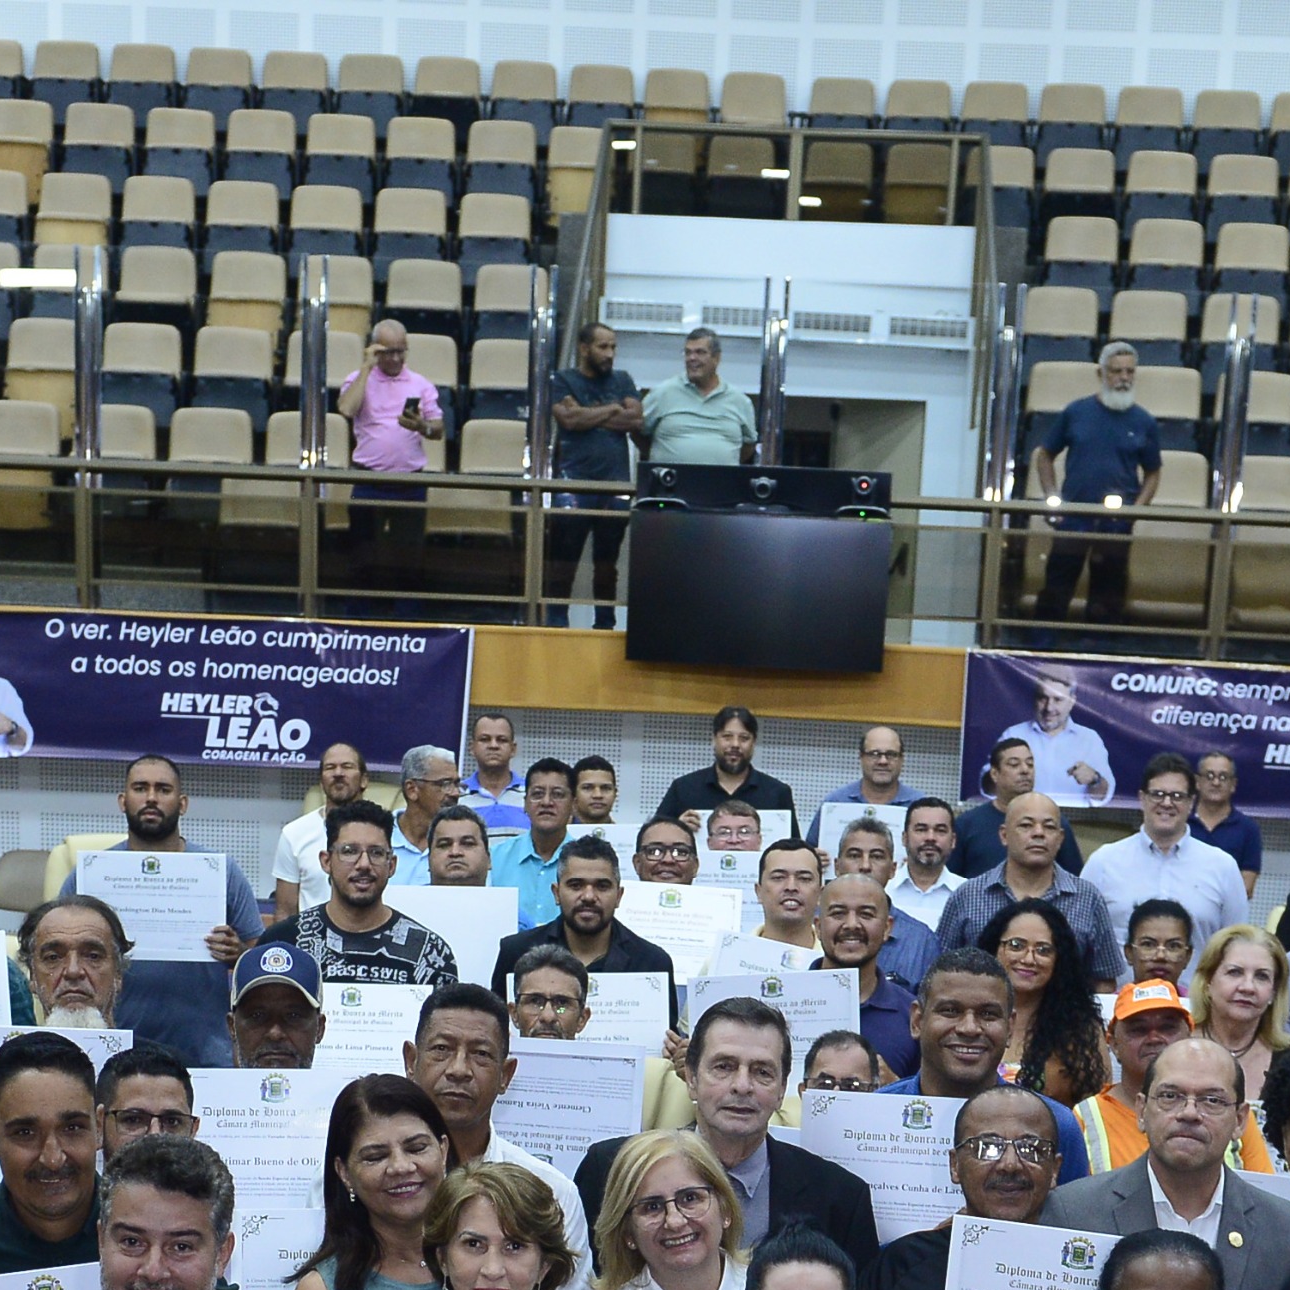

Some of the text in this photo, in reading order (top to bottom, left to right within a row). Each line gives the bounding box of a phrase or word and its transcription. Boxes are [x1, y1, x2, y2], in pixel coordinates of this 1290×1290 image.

[44, 618, 427, 655] O ver. Heyler Leão cumprimenta
[70, 654, 400, 687] a todos os homenageados!
[1111, 672, 1218, 697] COMURG:
[160, 691, 254, 715] HEYLER
[205, 715, 311, 750] LEÃO
[1151, 706, 1257, 734] diferença
[201, 748, 261, 762] CORAGEM
[269, 750, 309, 766] AÇÃO
